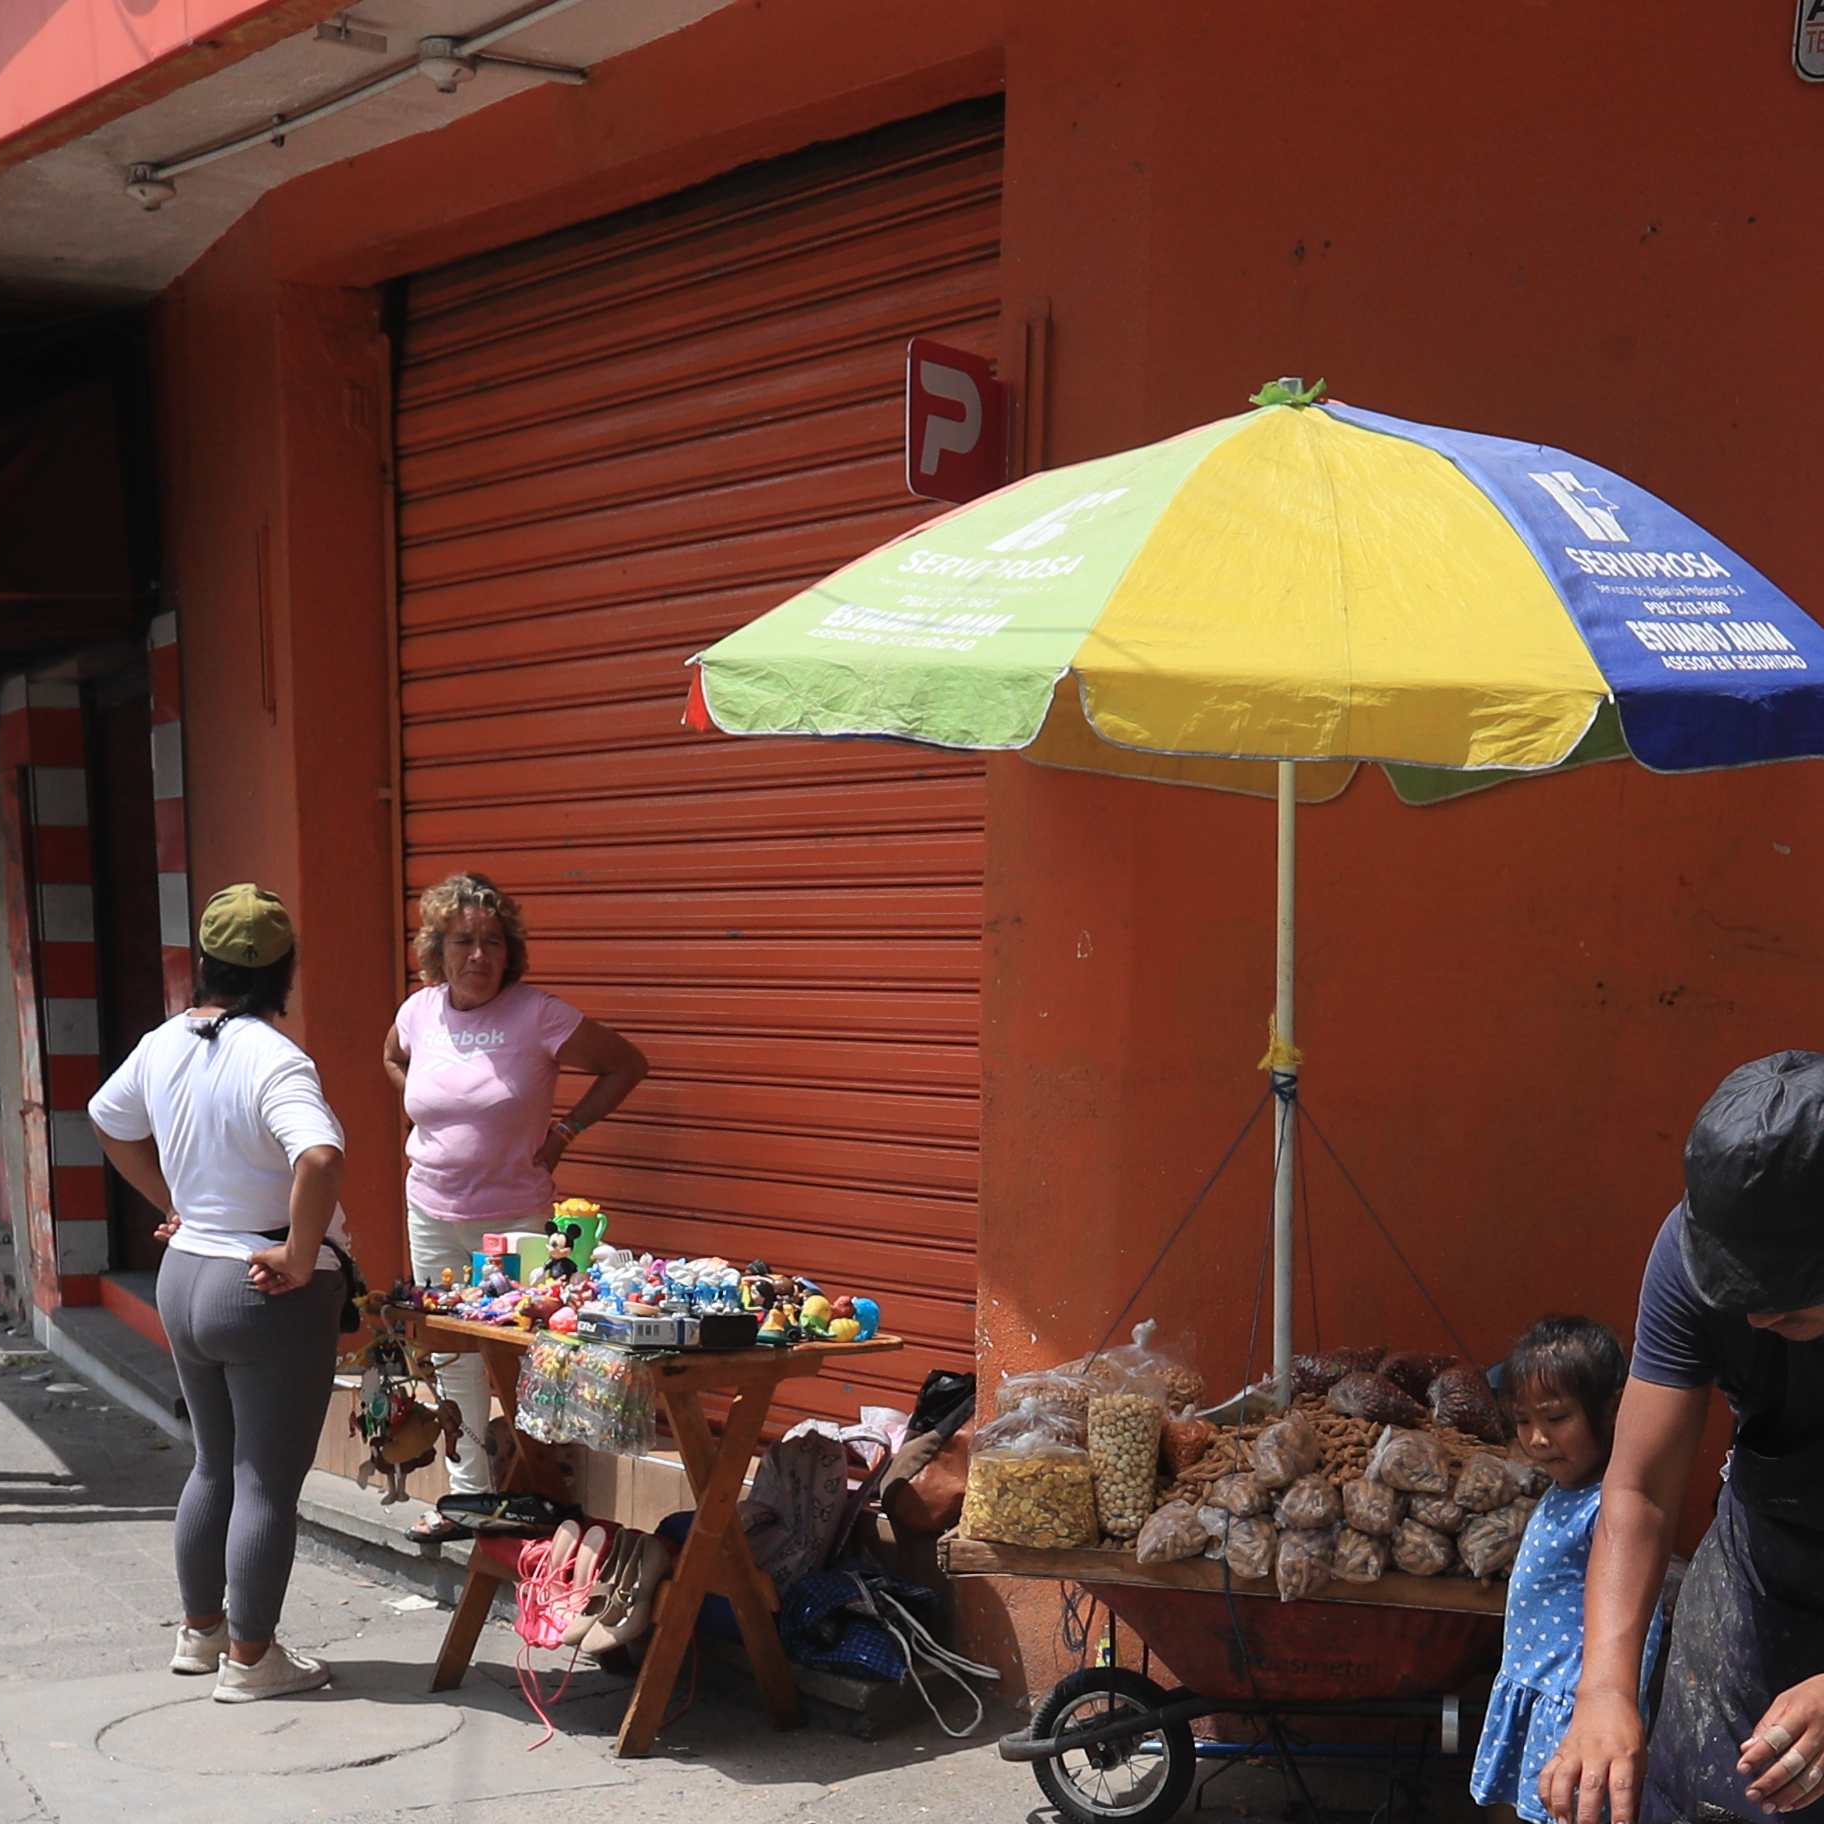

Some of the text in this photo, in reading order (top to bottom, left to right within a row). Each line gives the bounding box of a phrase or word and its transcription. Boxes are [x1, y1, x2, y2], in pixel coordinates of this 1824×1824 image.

[1564, 546, 1732, 578] SERVIPROSA
[1625, 620, 1797, 653] ESTUARDO ARANA
[1661, 655, 1808, 672] ASESOR EN SEGURIDAD
